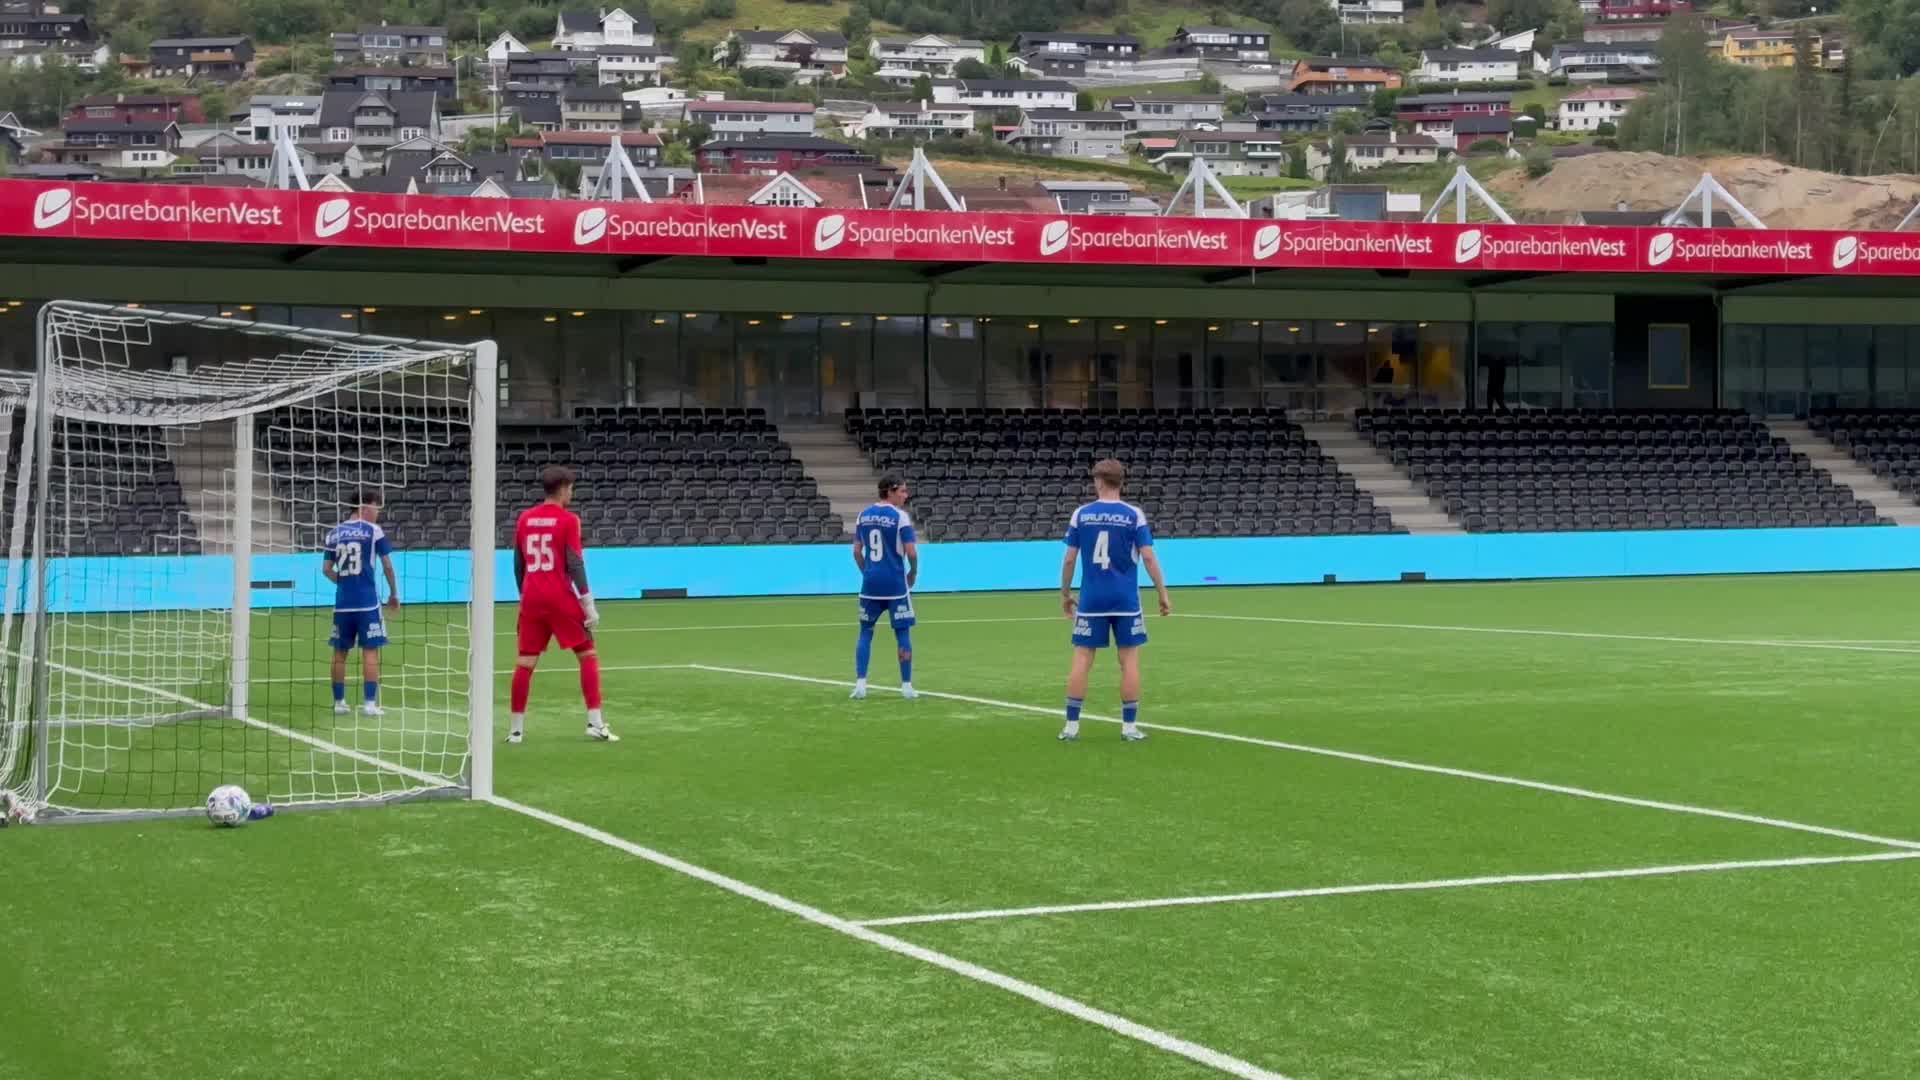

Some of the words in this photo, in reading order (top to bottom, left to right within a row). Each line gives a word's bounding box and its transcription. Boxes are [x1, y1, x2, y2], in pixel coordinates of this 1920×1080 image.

[336, 541, 362, 576] 23
[526, 533, 554, 572] 55
[869, 528, 883, 562] 9
[1092, 530, 1111, 570] 4
